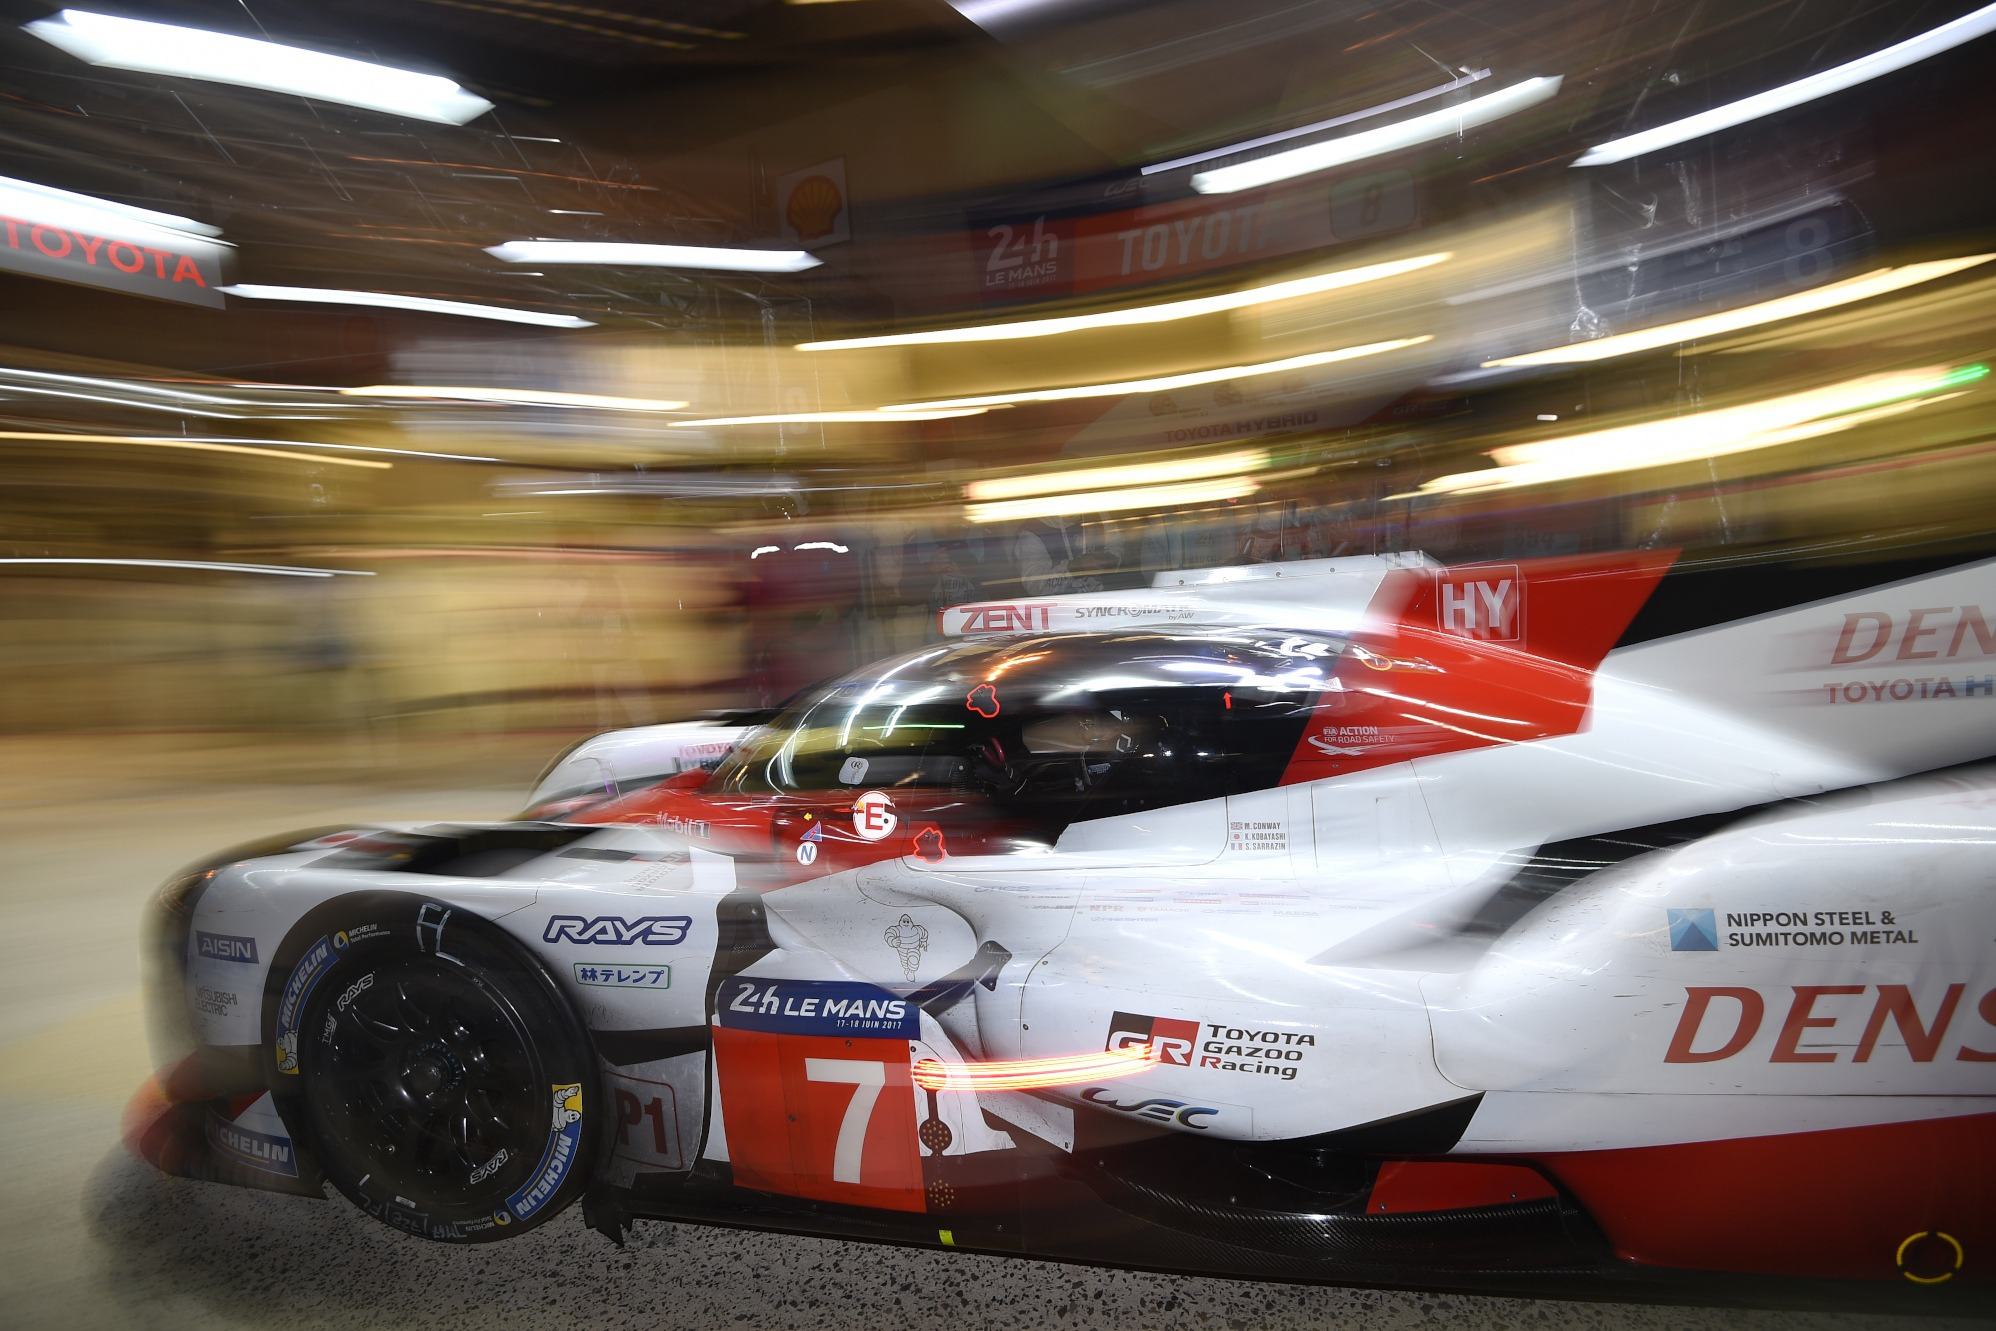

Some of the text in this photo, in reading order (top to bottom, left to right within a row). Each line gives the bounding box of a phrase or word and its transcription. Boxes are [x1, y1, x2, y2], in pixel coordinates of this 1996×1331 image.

[0, 214, 207, 288] TOYOTA
[986, 216, 1058, 271] 24h
[986, 261, 1057, 287] LE MANS
[1164, 410, 1318, 443] TOYOTA HYBRID
[1442, 579, 1512, 630] HY
[960, 603, 1057, 633] ZENT
[1823, 677, 1957, 704] TOYOTA
[1338, 736, 1361, 744] ROAD
[1362, 735, 1395, 743] SAFETY
[1340, 726, 1378, 735] ACTION
[865, 802, 883, 830] E
[1253, 822, 1280, 830] CONWAY
[1252, 832, 1286, 841] KOBAYASHI
[1253, 842, 1286, 851] SARRAZIN
[800, 845, 812, 861] N
[348, 924, 378, 937] MICHELIN
[543, 914, 692, 945] RAYS
[1726, 910, 1895, 927] NIPPON STEEL &
[201, 937, 251, 958] AISIN
[1729, 930, 1918, 947] SUMITOMO METAL
[283, 943, 328, 1028] MICHELIN
[580, 967, 665, 984] 林テレンプ
[337, 973, 374, 1012] RAYS
[729, 983, 906, 1020] 24h LE MANS
[837, 1020, 902, 1030] 17-18 JUIN 2017
[1206, 1024, 1316, 1046] TOYOTA
[1203, 1041, 1303, 1061] GAZOO
[1200, 1055, 1298, 1080] Racing
[805, 1057, 886, 1184] 7
[1080, 1087, 1219, 1129] WEC
[470, 1148, 508, 1184] RAYS
[515, 1133, 573, 1216] MICHELIN
